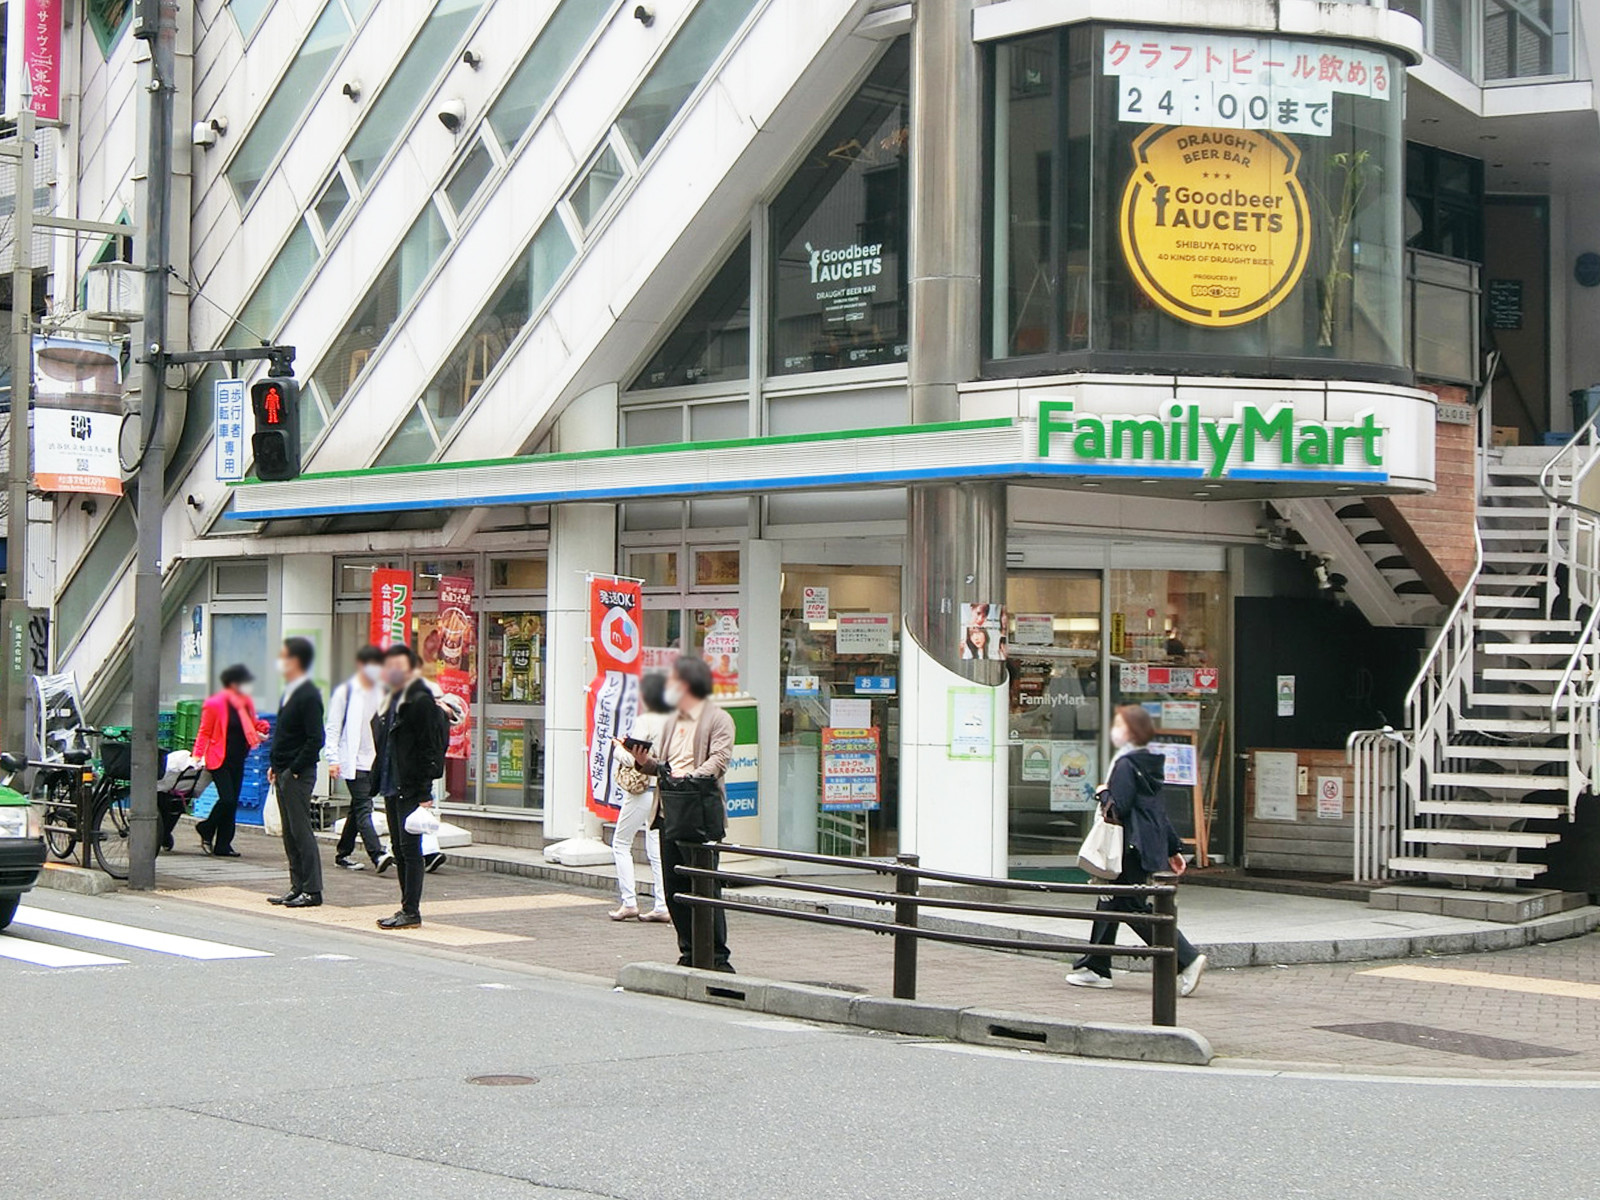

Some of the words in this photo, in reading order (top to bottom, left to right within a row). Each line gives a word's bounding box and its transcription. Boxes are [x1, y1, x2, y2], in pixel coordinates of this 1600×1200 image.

[1108, 39, 1389, 91] クラフトビール飲める
[1126, 86, 1330, 128] 24:00まで
[1177, 132, 1257, 154] DRAUGHT
[1182, 149, 1220, 165] BEER
[1223, 150, 1251, 168] BAR
[1175, 186, 1284, 209] Goodbeer
[821, 243, 882, 263] Goodbeer
[1175, 239, 1221, 250] SHIBUYA
[1222, 242, 1257, 252] TOKYO
[1170, 254, 1196, 262] KINDS
[1210, 255, 1251, 264] DRAUGHT
[1252, 258, 1275, 266] BEER
[816, 288, 846, 300] DRAUGHT
[846, 286, 862, 296] BEER
[863, 285, 877, 293] BAR
[219, 389, 229, 438] 自転車
[230, 388, 241, 438] 歩行者
[1036, 400, 1384, 478] FamilyMart
[393, 585, 407, 645] ファミ
[1019, 692, 1086, 708] FamilyMart
[727, 798, 755, 811] OPEN
